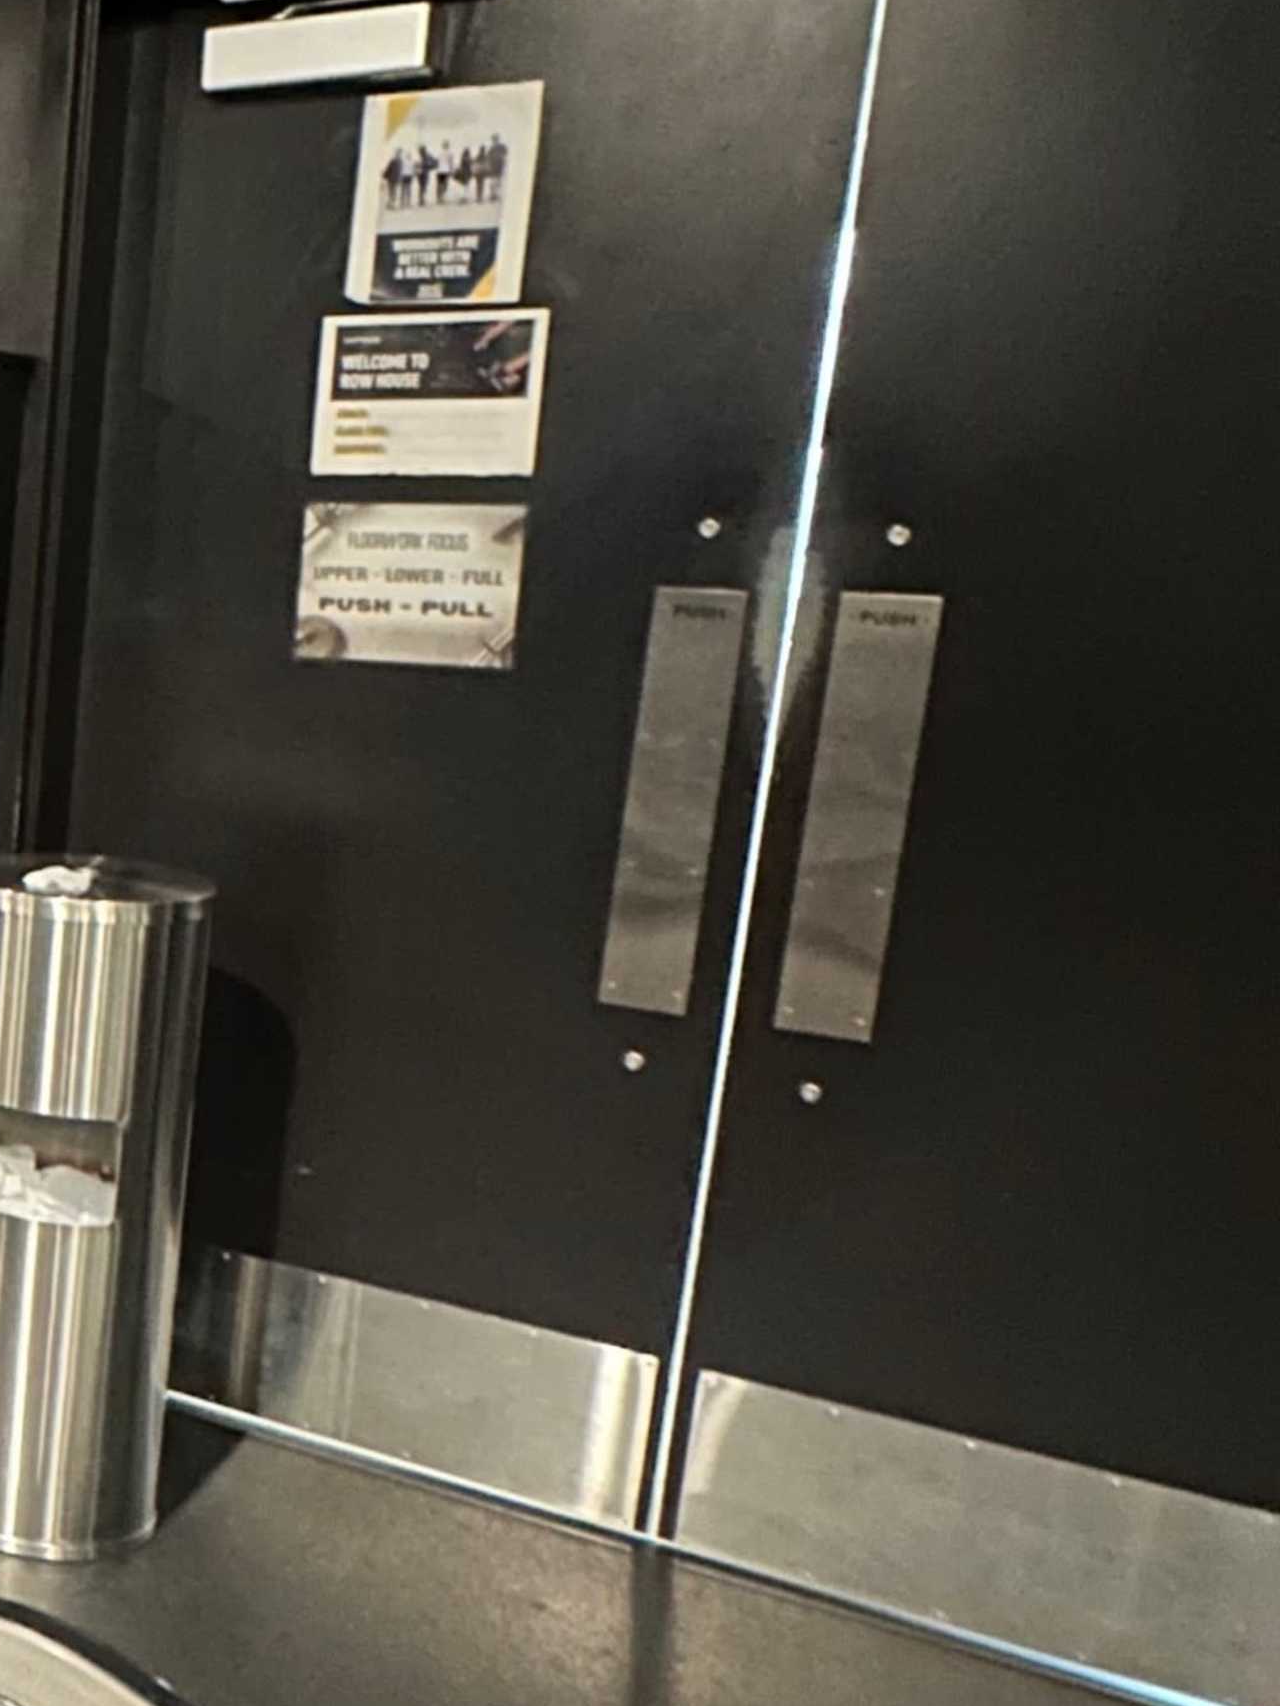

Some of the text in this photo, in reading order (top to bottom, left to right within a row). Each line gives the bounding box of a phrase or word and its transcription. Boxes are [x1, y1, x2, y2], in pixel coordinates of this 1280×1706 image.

[341, 352, 430, 370] WELCOME TO
[338, 372, 421, 389] ROW HOUSE
[427, 532, 470, 552] FOCUS
[313, 566, 369, 582] UPPER
[385, 567, 444, 584] LOWER
[462, 570, 504, 587] FULL
[319, 597, 392, 613] PUSH
[421, 600, 493, 618] PULL
[673, 604, 726, 620] PUSH
[860, 609, 916, 626] PUSH
